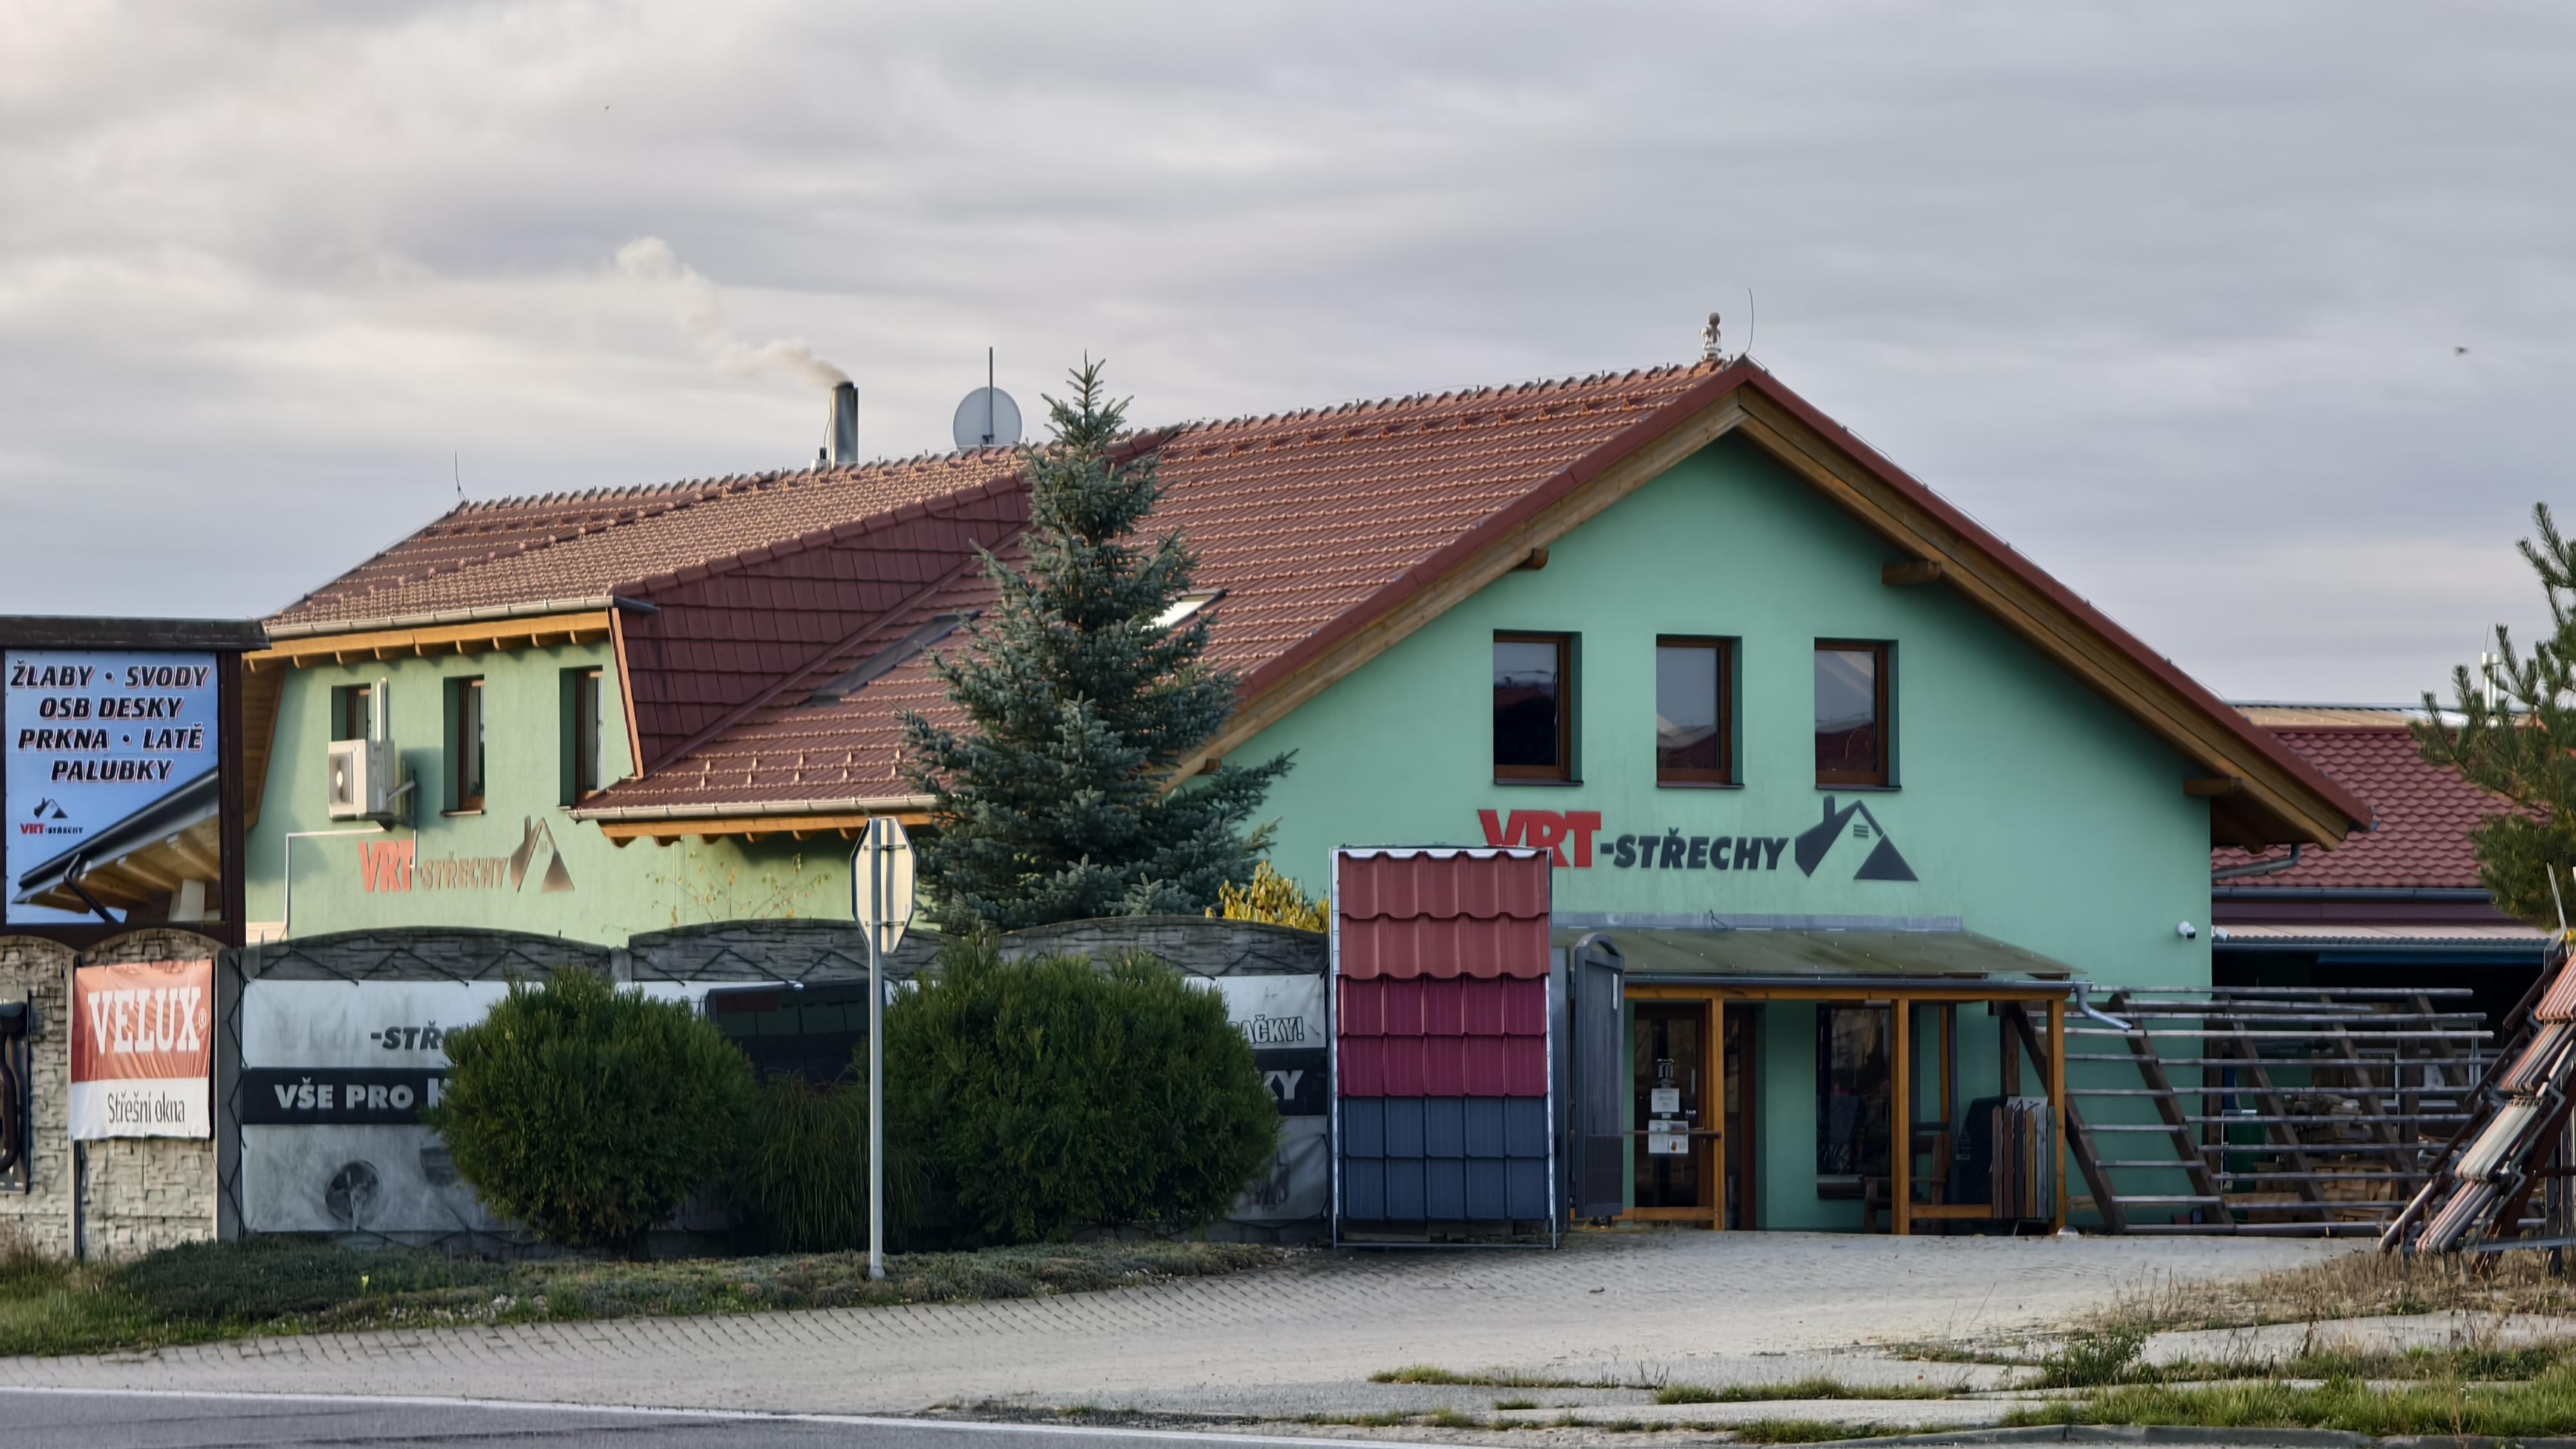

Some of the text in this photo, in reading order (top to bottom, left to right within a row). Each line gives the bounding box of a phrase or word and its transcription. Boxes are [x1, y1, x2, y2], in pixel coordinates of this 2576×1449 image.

[10, 659, 209, 688] ŽLABY SVODY
[39, 696, 183, 719] OSB DESKY
[18, 723, 204, 752] PRKNA LATĚ
[51, 760, 173, 782] PALUBKY
[274, 1076, 333, 1109] VŠE
[346, 1084, 414, 1109] PRO
[108, 1091, 185, 1124] Střešní okna
